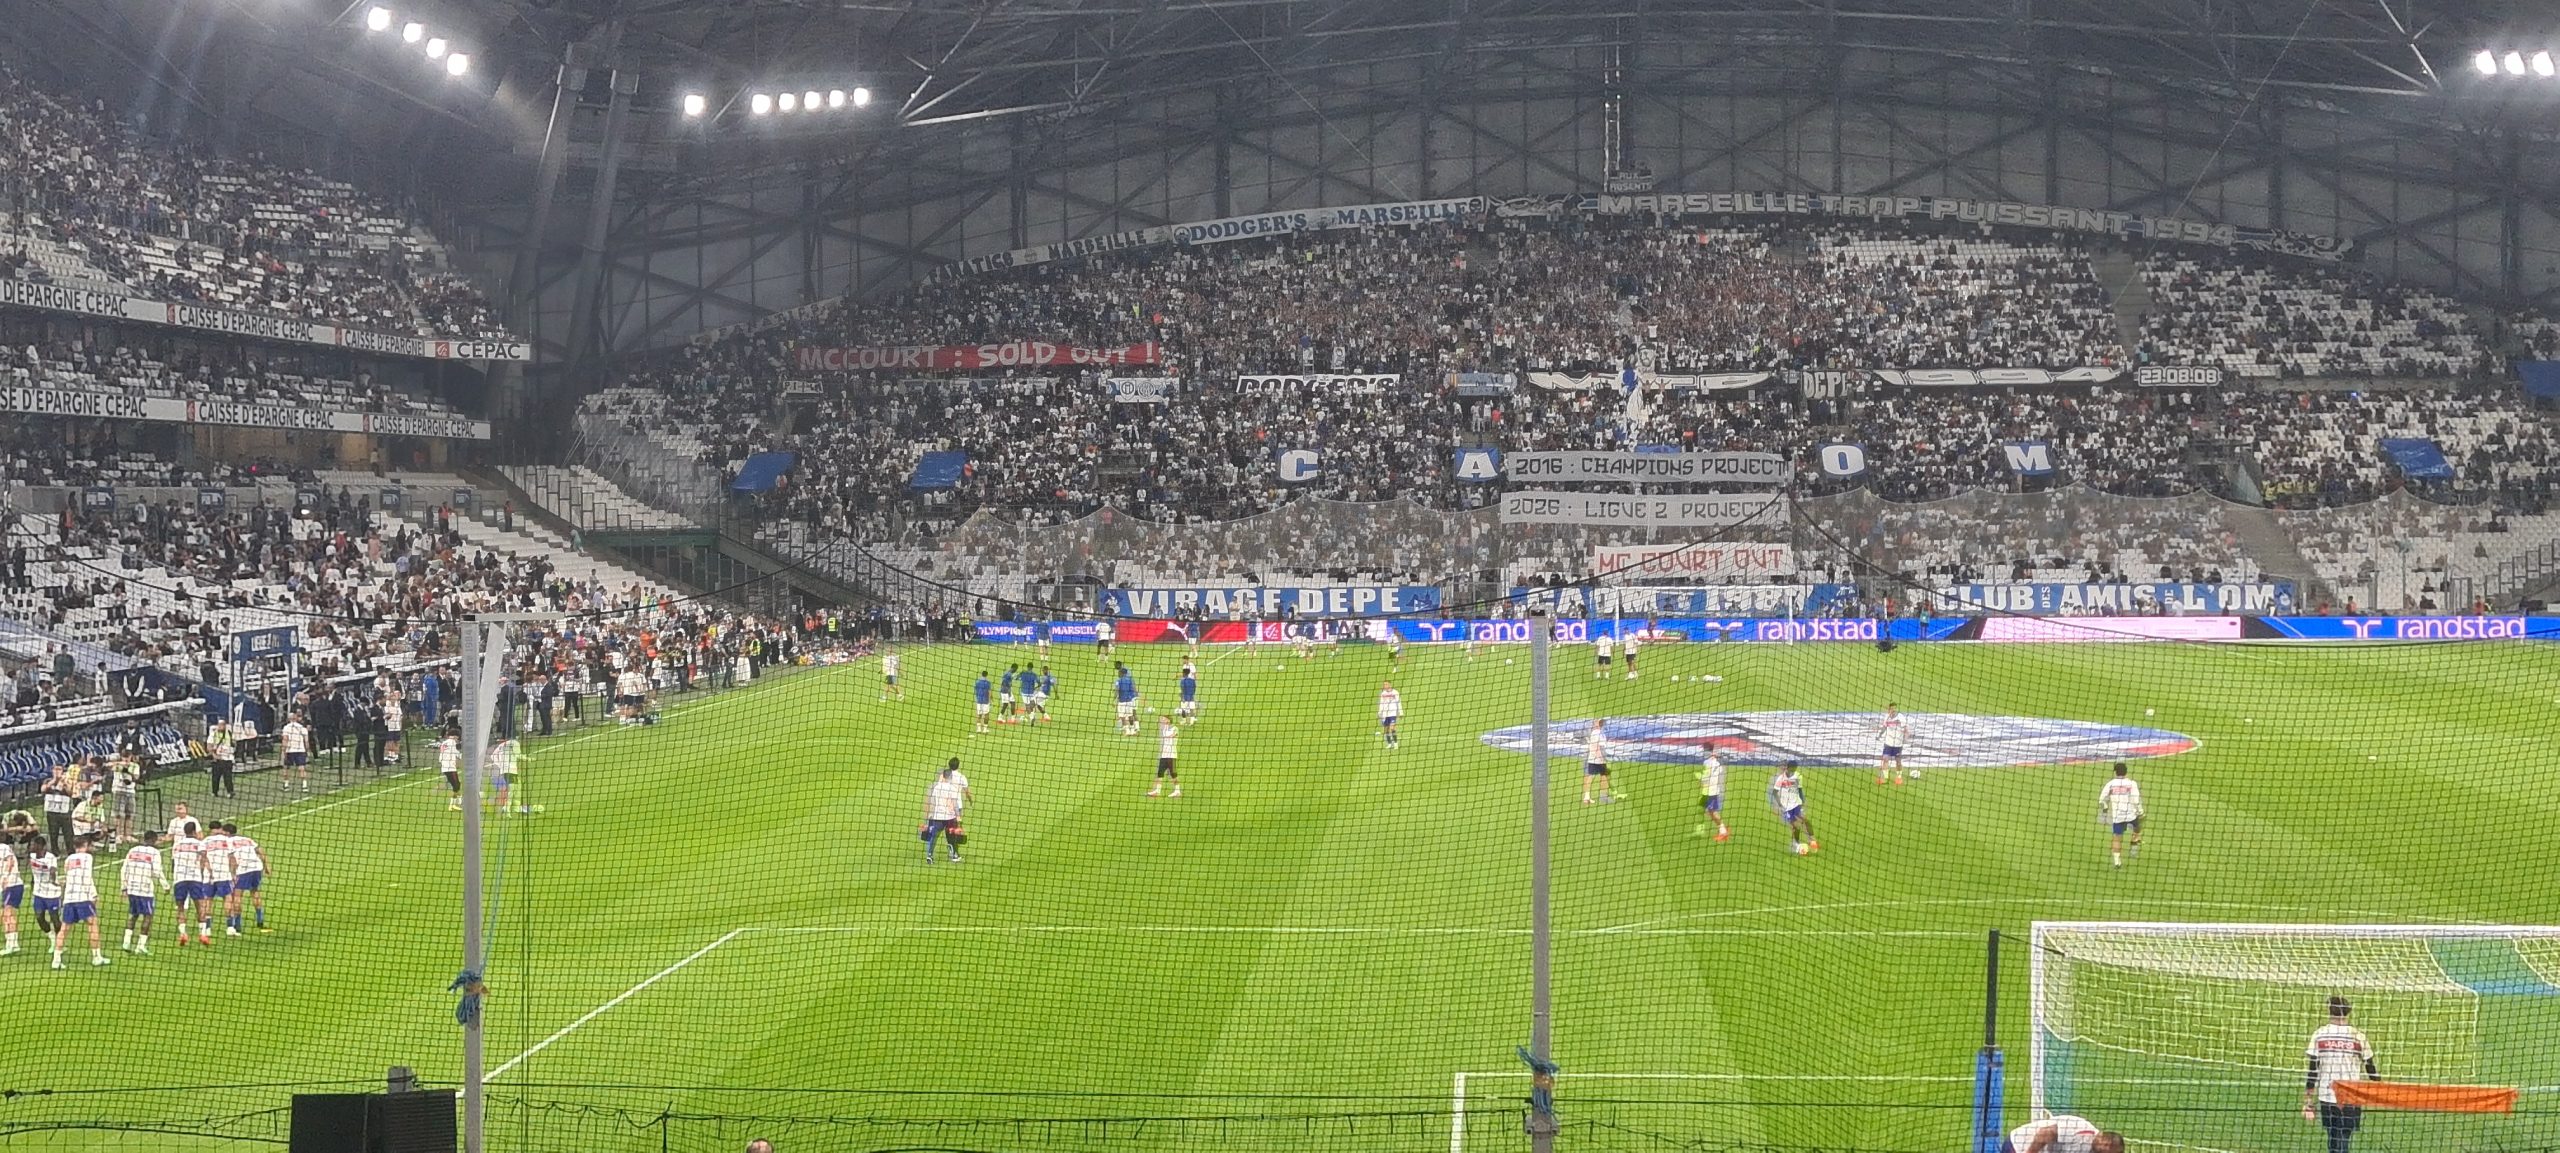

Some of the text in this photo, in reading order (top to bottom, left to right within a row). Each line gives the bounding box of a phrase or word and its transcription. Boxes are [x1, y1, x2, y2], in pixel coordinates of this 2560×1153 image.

[1190, 213, 1307, 242] DODGER'S
[1600, 193, 2236, 247] MARSEILLE TROP PUISSANT 1994
[1048, 230, 1147, 260] MARSEILLE
[86, 292, 128, 317] CEPAC
[179, 305, 314, 341] CAISSE D'EPARGNE CEPAC
[345, 330, 423, 356] CAISSE D'EPARGNE
[457, 342, 521, 359] CEPAC
[800, 345, 941, 370] MCCOURT
[977, 342, 1057, 368] SOLD
[1070, 346, 1131, 364] OUT
[1145, 341, 1155, 363] !
[2139, 368, 2218, 385] 23.08.08
[22, 388, 101, 412] D'EPARGNE
[106, 394, 147, 417] CEPAC
[199, 402, 334, 429] CAISSE D'EPARGNE CEPAC
[373, 415, 475, 438] CAISSE D'EPARGNE CEPAC
[1281, 445, 2052, 481] C A O M
[1516, 458, 1562, 475] 2016
[1582, 457, 1693, 475] CHAMPIONS
[1509, 499, 1560, 516] 2026
[1585, 500, 1647, 518] LIGUE
[1655, 503, 1668, 518] 2
[1681, 501, 1768, 518] PROJECT
[1641, 549, 1723, 572] COURT
[1734, 549, 1784, 569] OUT
[1127, 588, 1400, 615] VIRAGE DEPE
[1936, 586, 2034, 611] CLUB
[2060, 585, 2155, 611] AMIS
[2183, 585, 2276, 611] L'OM
[977, 626, 1034, 636] OLYMPIE
[1470, 620, 1586, 641] randad
[1758, 618, 1878, 640] randstad
[2397, 616, 2526, 639] randstad
[464, 684, 477, 743] MARSEILLE
